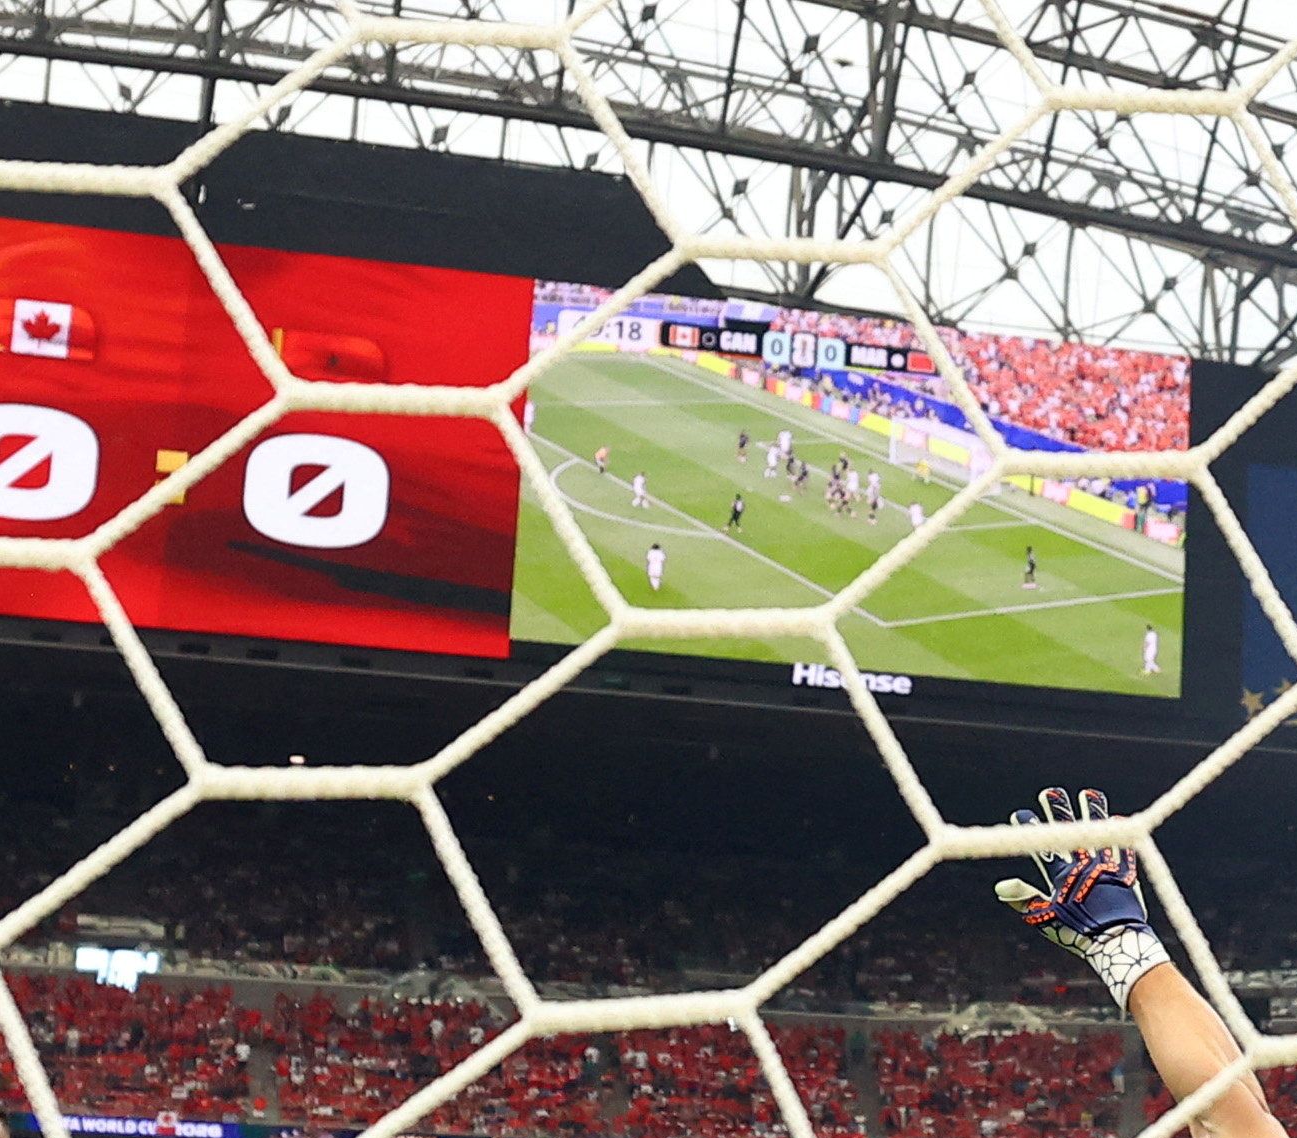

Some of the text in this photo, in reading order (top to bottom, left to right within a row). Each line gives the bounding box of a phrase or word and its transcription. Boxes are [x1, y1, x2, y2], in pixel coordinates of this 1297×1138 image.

[571, 314, 642, 341] :18
[243, 433, 390, 549] 0
[792, 662, 912, 695] Hisnse
[82, 1117, 137, 1135] WORLD
